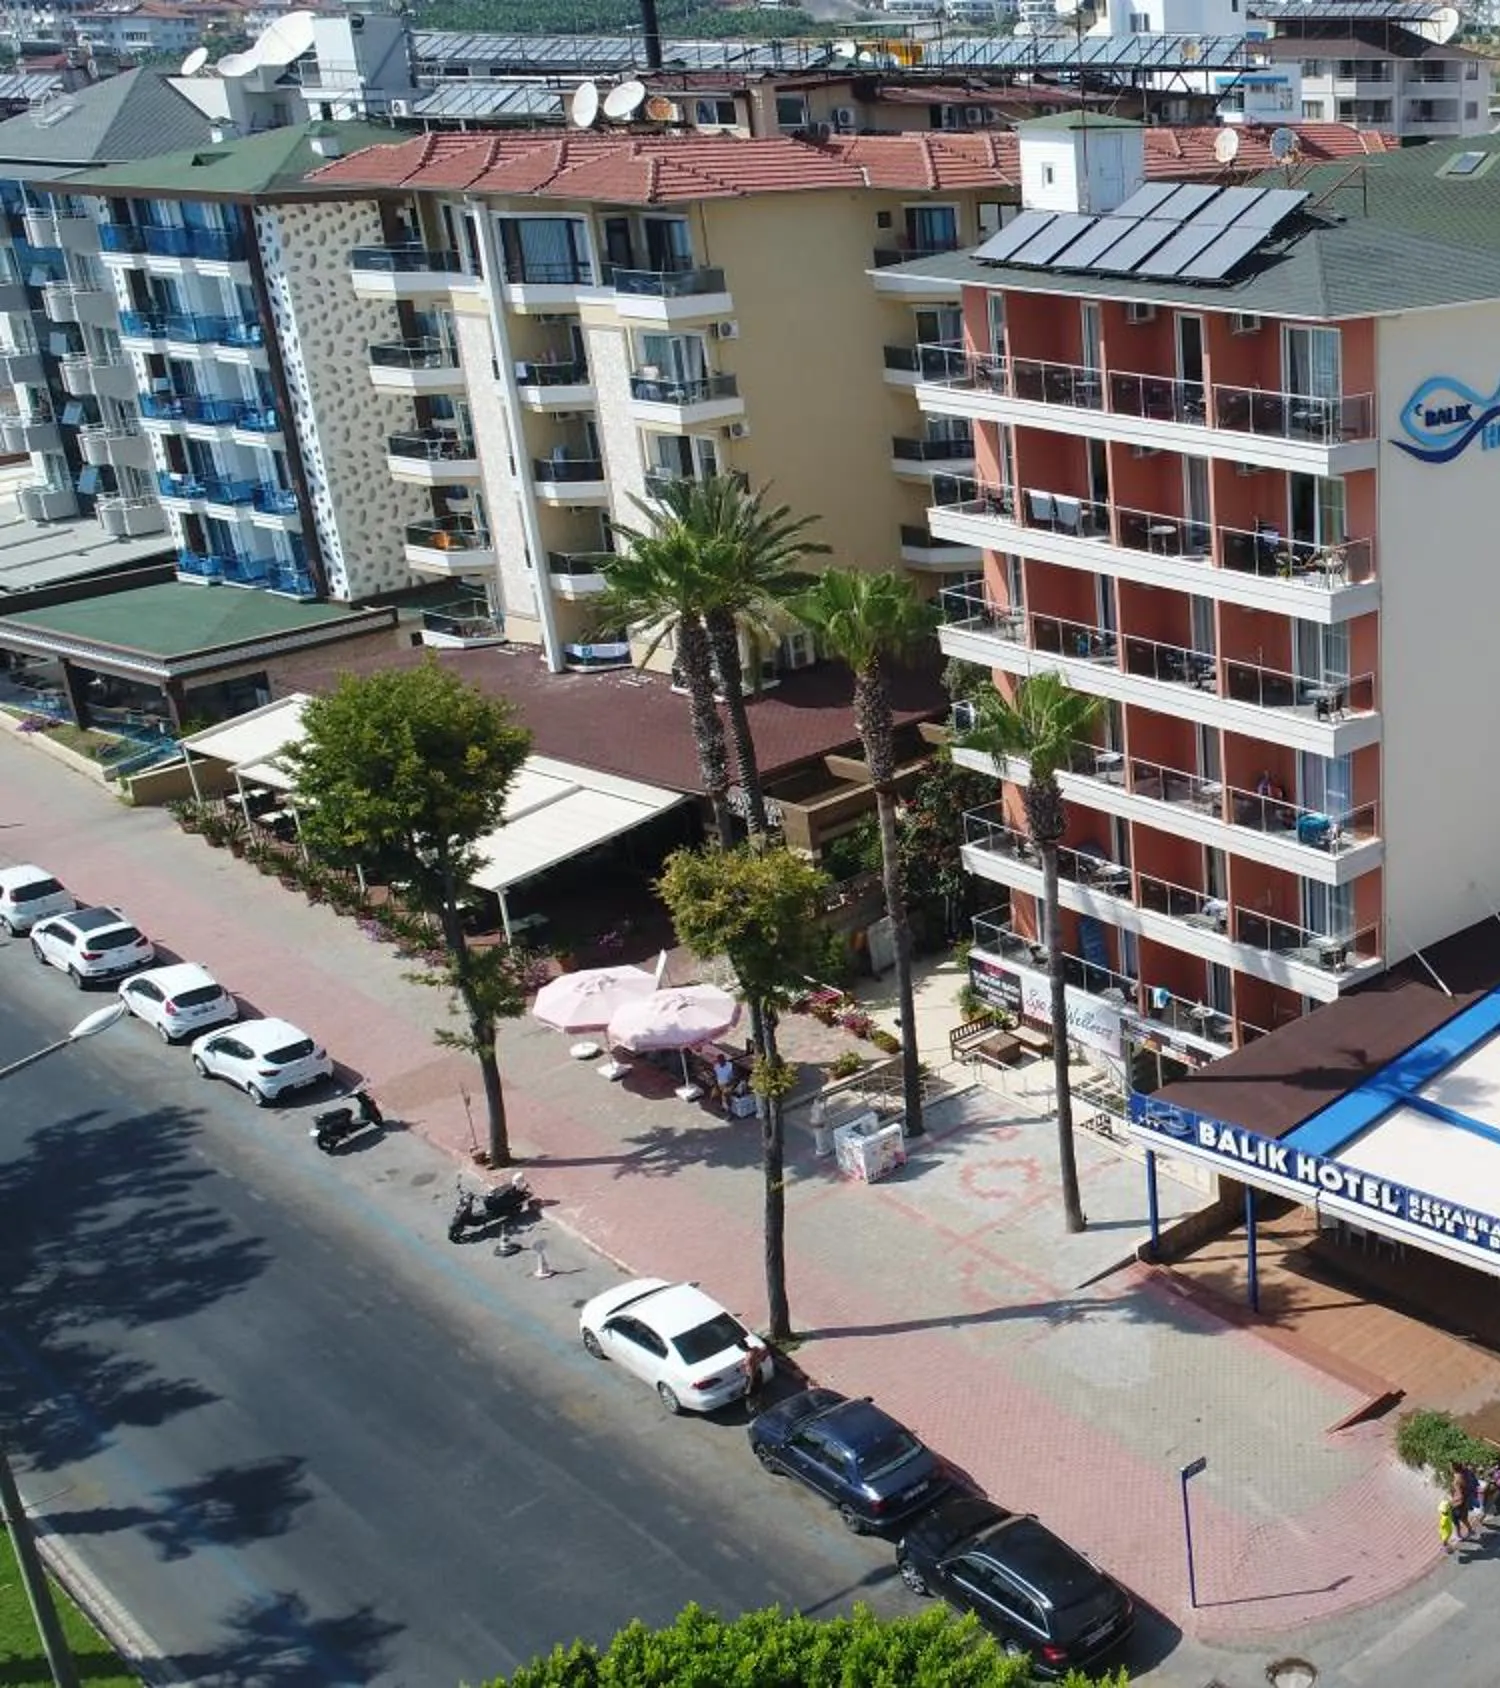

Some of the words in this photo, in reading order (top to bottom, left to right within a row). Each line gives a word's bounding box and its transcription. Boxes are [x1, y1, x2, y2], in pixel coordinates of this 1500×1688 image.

[1199, 1120, 1289, 1174] BALIK
[1297, 1153, 1400, 1213] HOTEL
[1409, 1208, 1456, 1233] CAFE
